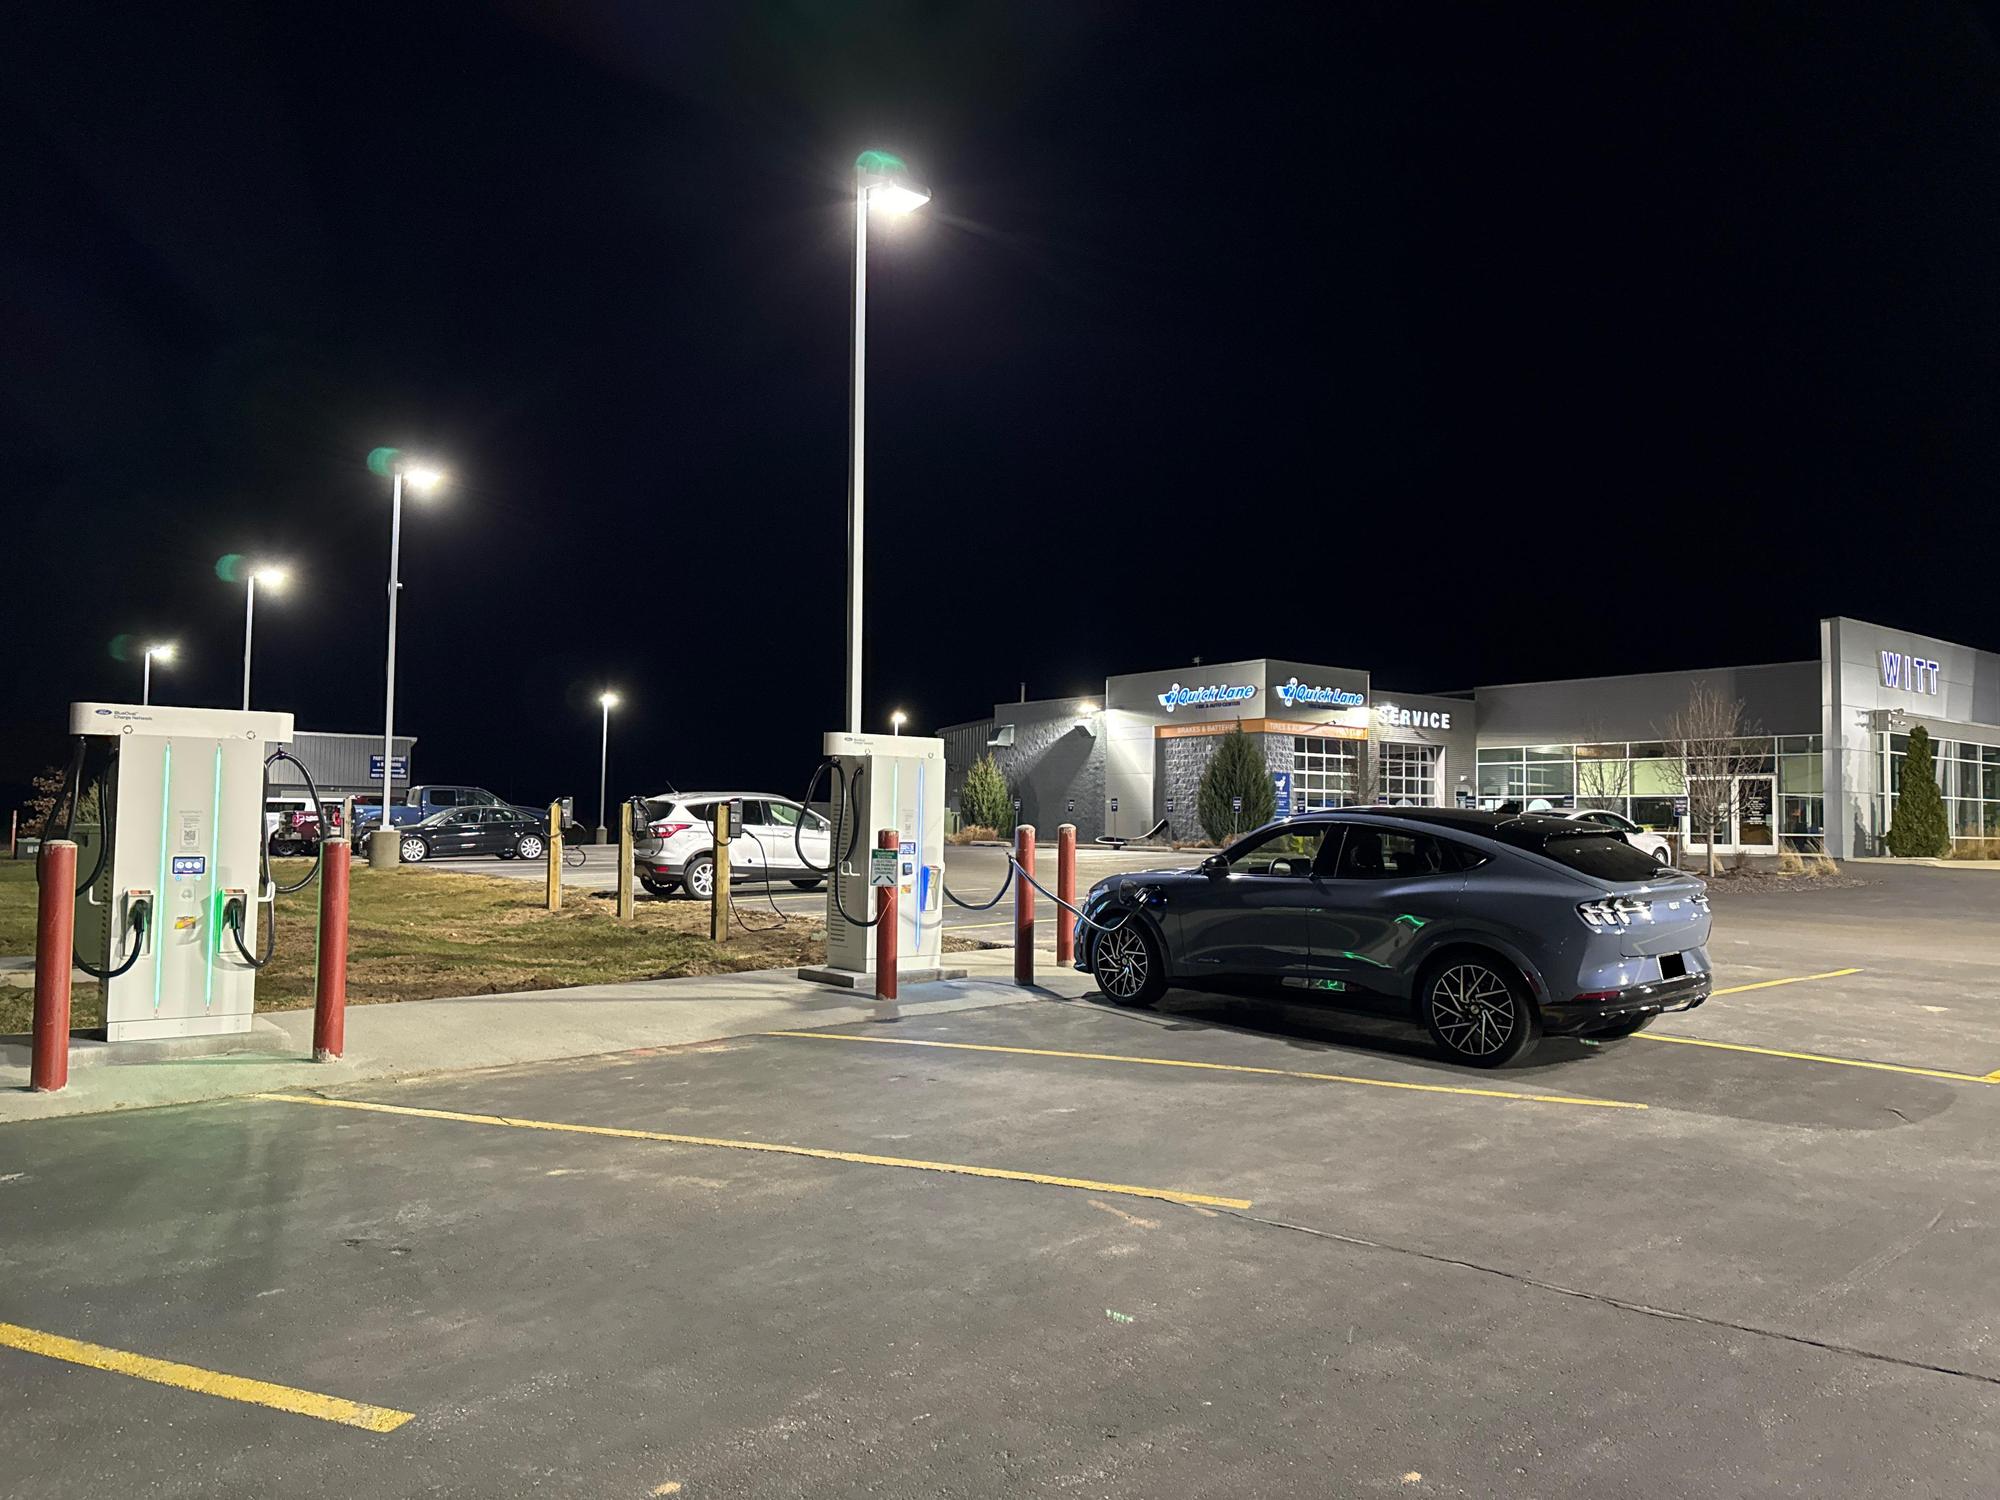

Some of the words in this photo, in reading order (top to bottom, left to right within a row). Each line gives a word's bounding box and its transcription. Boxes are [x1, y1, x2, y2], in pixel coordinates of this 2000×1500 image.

[1881, 650, 1939, 695] WITT
[1178, 685, 1219, 706] Quick
[1217, 684, 1256, 701] Lane
[1296, 684, 1334, 703] Quick
[1332, 688, 1364, 706] Lane
[1378, 706, 1451, 729] SERVICE
